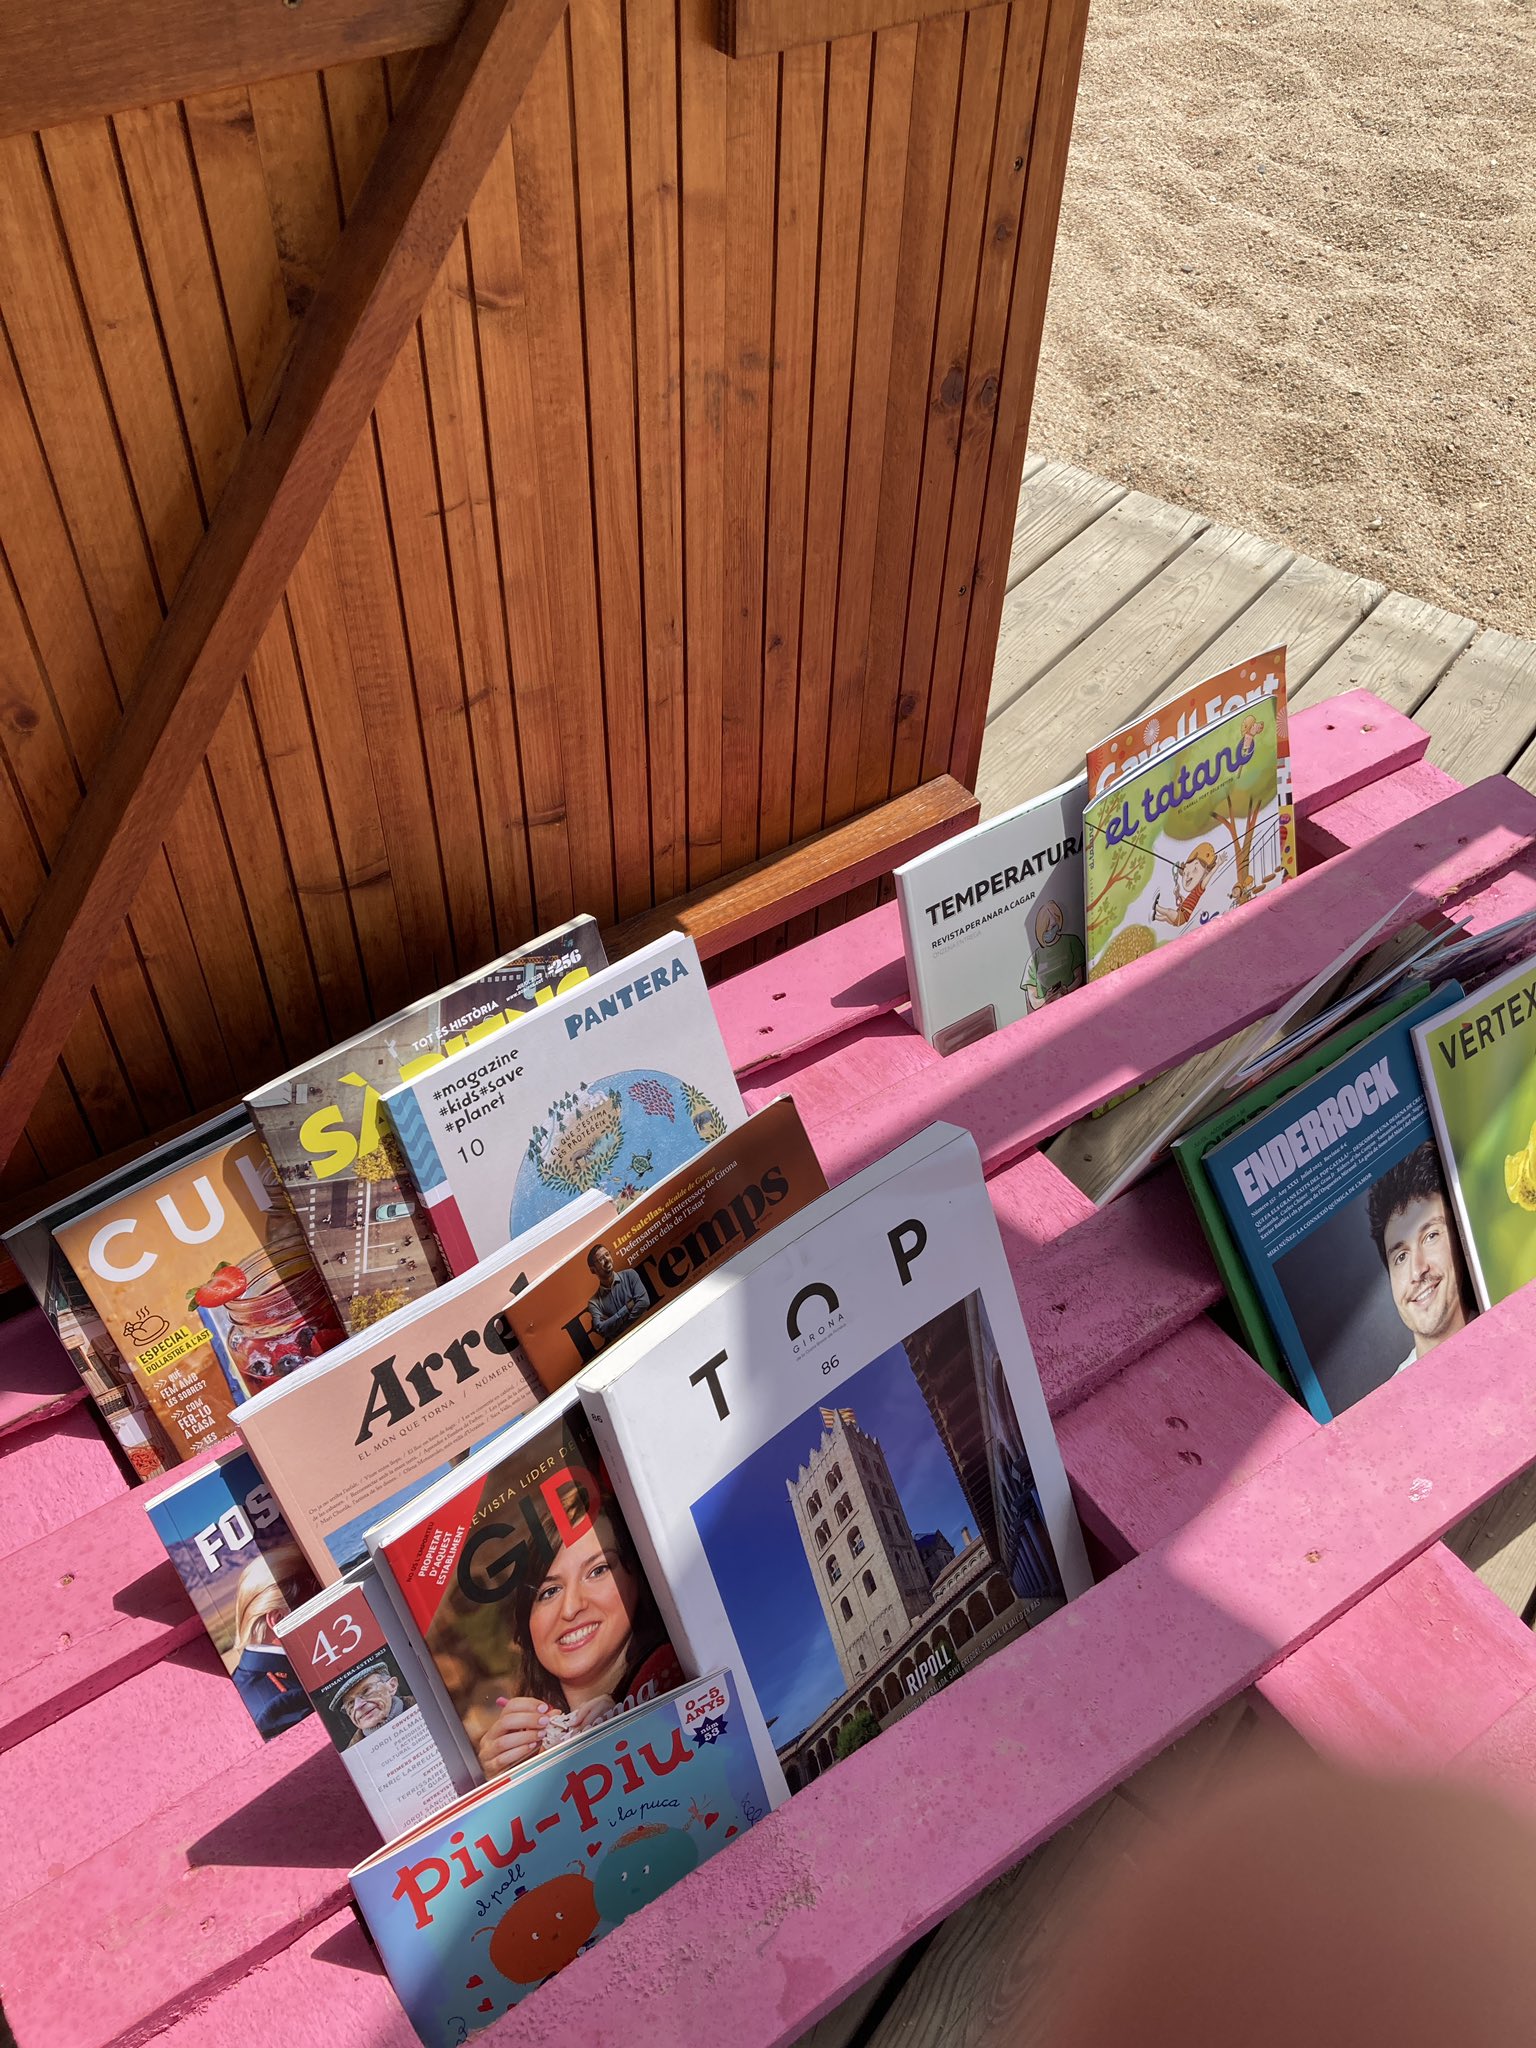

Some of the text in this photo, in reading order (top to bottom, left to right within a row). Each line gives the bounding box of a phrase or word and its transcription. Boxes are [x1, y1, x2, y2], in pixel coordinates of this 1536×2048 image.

[1105, 814, 1140, 850] el
[1142, 737, 1255, 820] tatano
[930, 891, 1035, 949] REVISTA PER ANAR A CAGAR
[565, 958, 689, 1040] PANTERA
[412, 1032, 435, 1052] TOT
[447, 995, 499, 1032] HISTÒRIA
[432, 1047, 520, 1101] #magazine
[439, 1064, 525, 1118] #kids#save
[445, 1092, 506, 1134] #planet
[550, 1106, 607, 1155] EL QUE S'ESTIMA
[1232, 1056, 1399, 1207] ENDERROCK
[457, 1137, 485, 1164] 10
[556, 1117, 606, 1159] ES PROTEGEIX
[612, 1164, 716, 1249] Lluc Salellas, alcalde de Girona
[660, 1210, 672, 1223] els
[671, 1183, 705, 1215] interessos
[704, 1176, 715, 1188] de
[714, 1158, 738, 1181] Girona
[626, 1248, 641, 1265] per
[638, 1232, 660, 1253] sobre
[657, 1220, 674, 1238] dels
[672, 1212, 684, 1226] de
[138, 1326, 190, 1365] ESPECIAL
[144, 1329, 211, 1374] POLLASTRE A L'AST
[792, 1313, 844, 1354] GIRONA
[159, 1371, 199, 1399] FEM AMB
[821, 1354, 840, 1376] 86
[164, 1379, 208, 1408] LES SOBRES?
[184, 1397, 204, 1413] COM
[357, 1448, 372, 1461] EL
[371, 1432, 397, 1452] MÓN
[397, 1419, 420, 1437] QUE
[421, 1397, 456, 1423] TORNA
[473, 1359, 515, 1390] NÚMERO
[176, 1404, 213, 1430] FER-LO
[182, 1415, 216, 1439] A CASA
[591, 1412, 604, 1425] 86
[202, 1431, 218, 1445] LES
[470, 1485, 517, 1531] EVISTA
[518, 1455, 556, 1489] LÍDER
[558, 1439, 576, 1458] DE
[406, 1571, 414, 1582] NO
[410, 1562, 418, 1571] US
[417, 1528, 443, 1578] PROPIETAT
[428, 1531, 454, 1577] D'AQUEST
[435, 1527, 465, 1585] ESTABLIMENT
[311, 1612, 363, 1667] 43
[320, 1655, 374, 1693] PRIMAVERA-ESTIU
[905, 1644, 952, 1697] RIPOLL
[685, 1695, 725, 1725] ANYS
[700, 1721, 719, 1735] núm
[368, 1735, 392, 1754] JORDI
[703, 1727, 720, 1742] 53
[380, 1745, 411, 1768] CULTURAL
[386, 1758, 412, 1777] PRIMERS
[377, 1773, 401, 1793] ENRIC
[416, 1787, 427, 1796] DE
[617, 1804, 638, 1822] la
[641, 1797, 680, 1823] puca
[491, 1864, 526, 1905] poll
